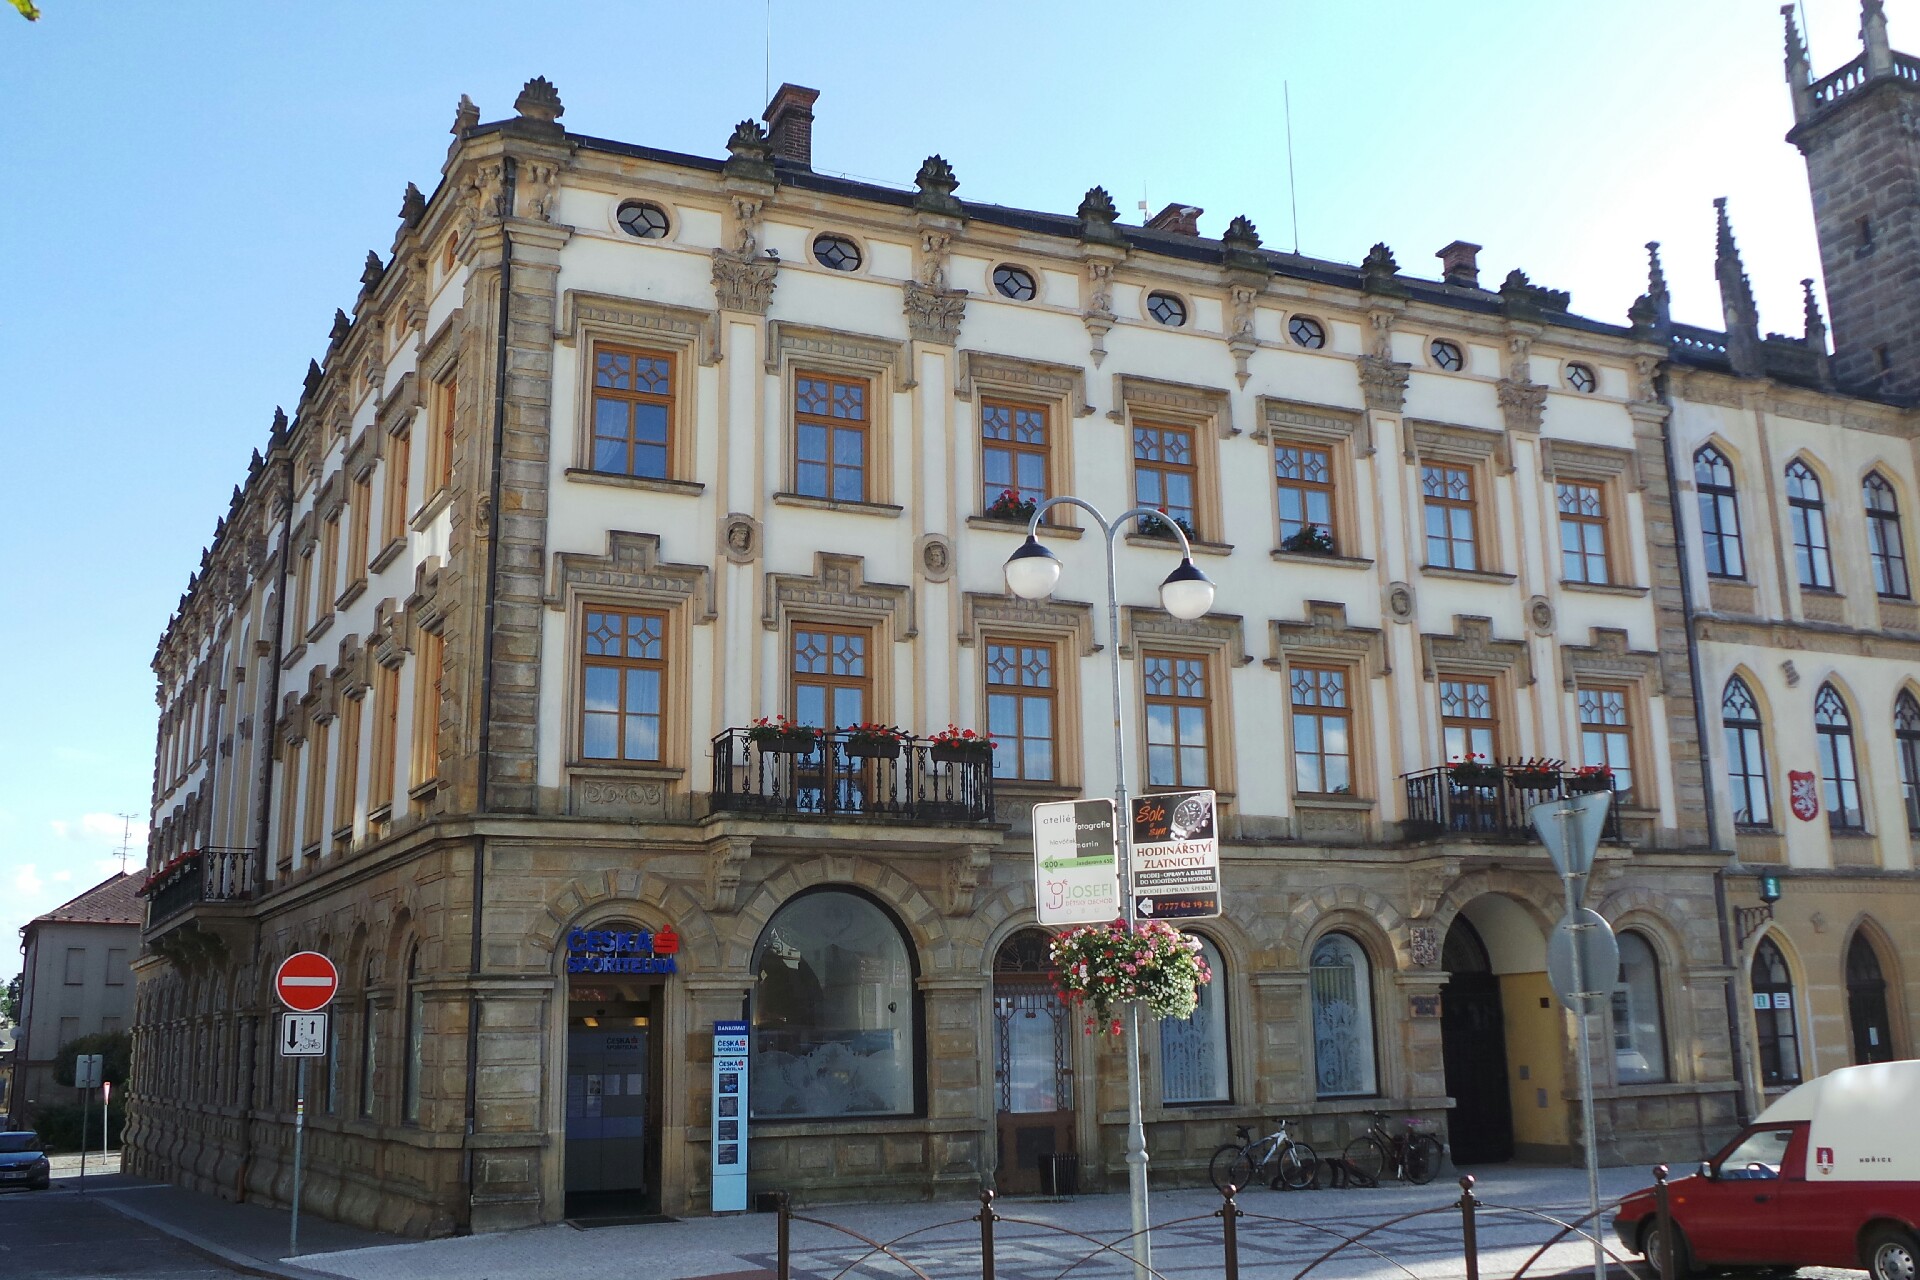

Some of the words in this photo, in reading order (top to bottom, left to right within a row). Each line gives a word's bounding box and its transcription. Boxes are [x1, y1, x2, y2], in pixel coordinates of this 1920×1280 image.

[1136, 800, 1165, 823] Šolc
[1148, 827, 1167, 839] syn
[1137, 840, 1212, 857] HODINÁŘSTVÍ
[1144, 853, 1206, 869] ZLATNICTVÍ
[1065, 883, 1113, 899] JOSEFI
[567, 925, 653, 952] ČESKÁ
[567, 953, 678, 974] SPOŘITELNA
